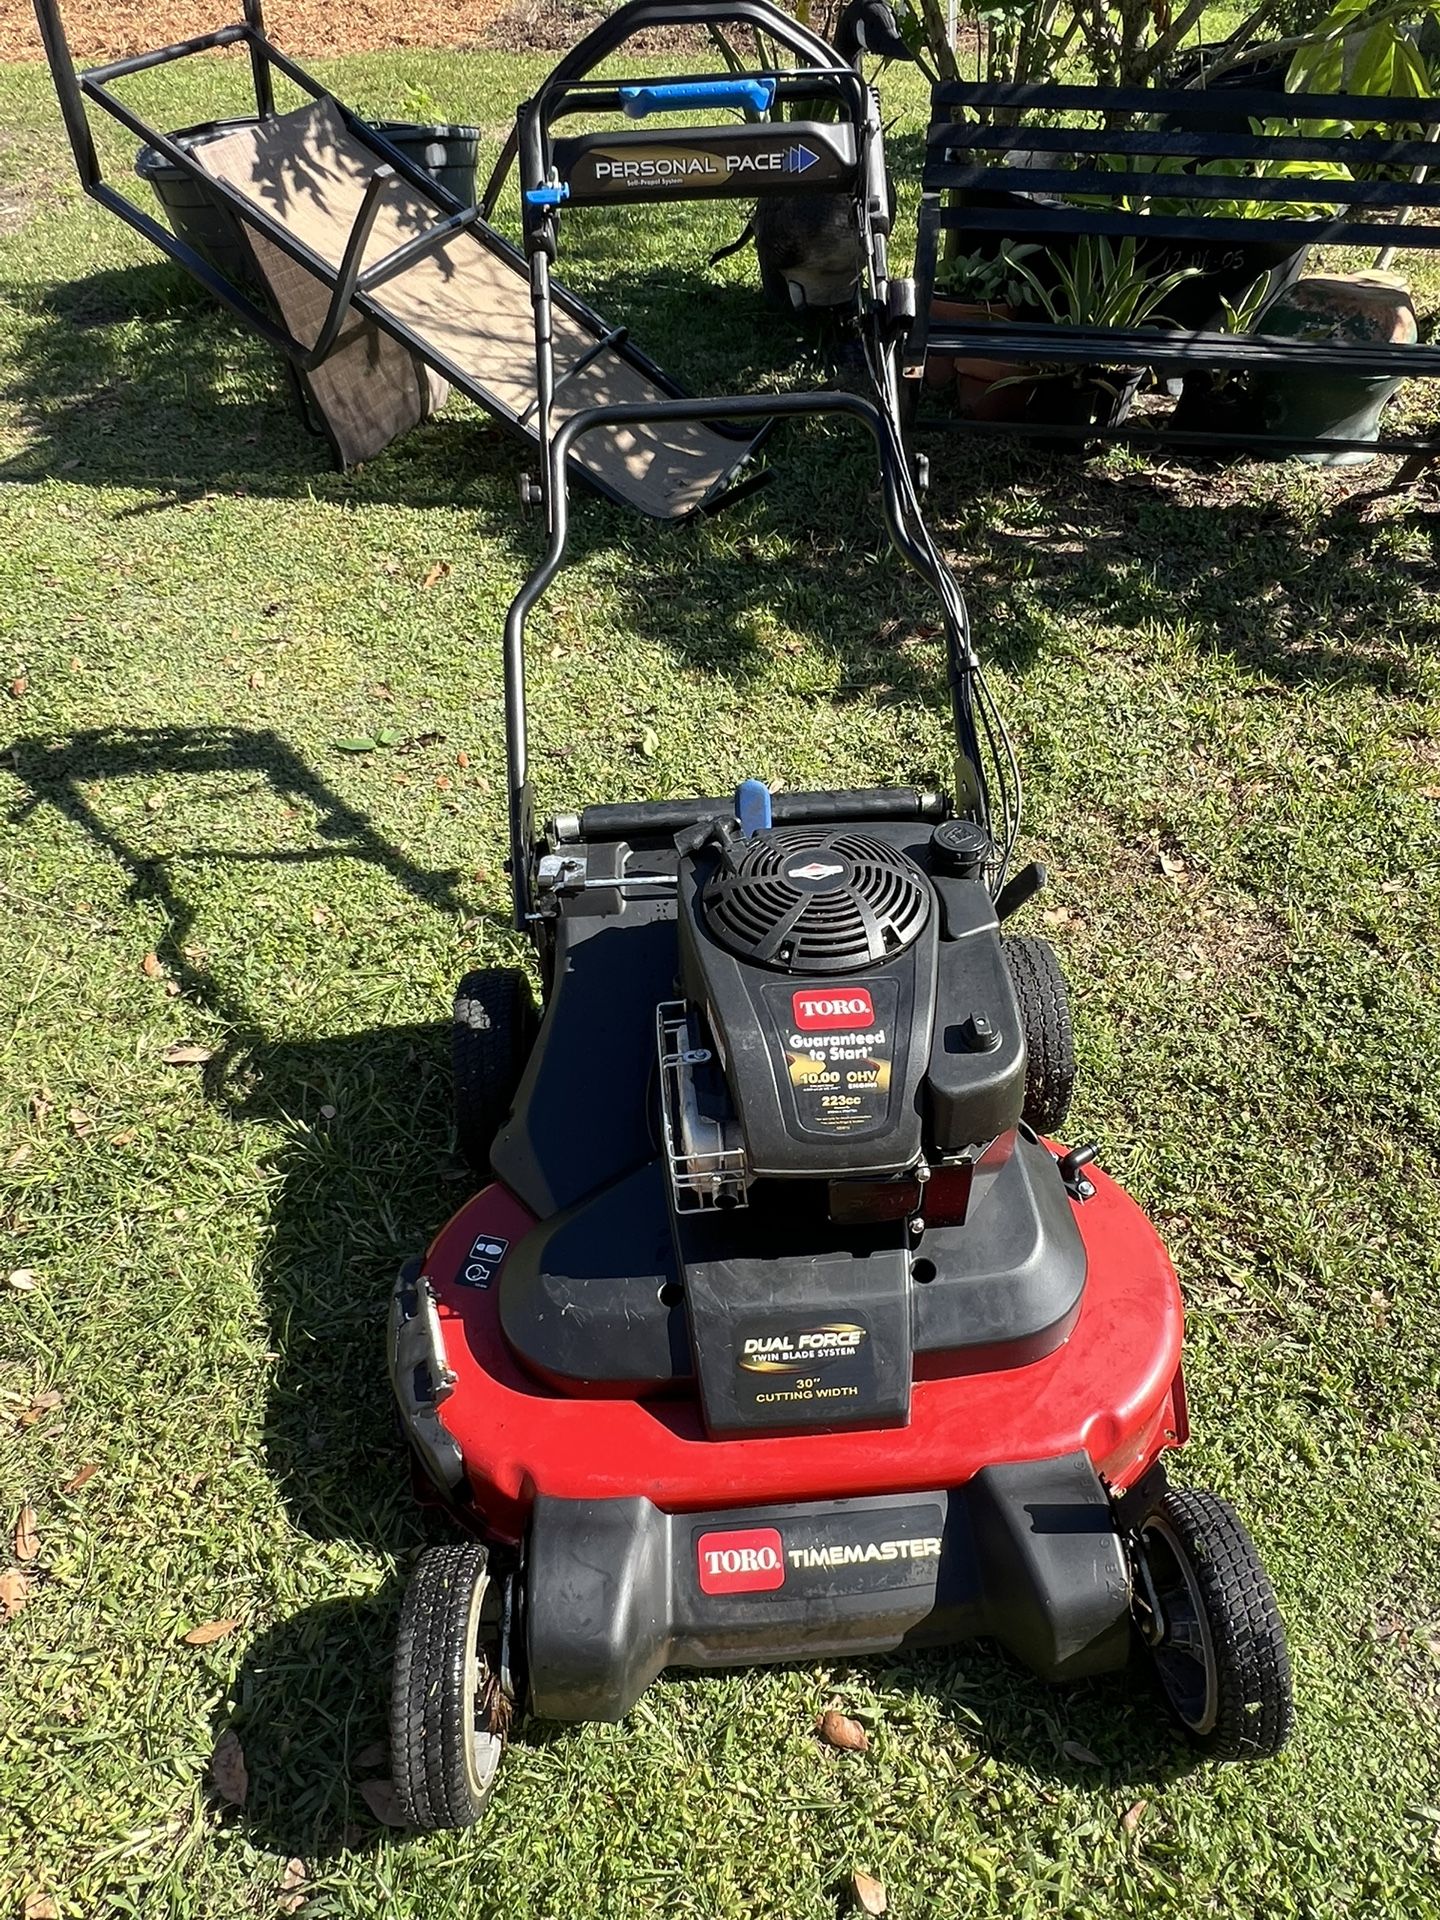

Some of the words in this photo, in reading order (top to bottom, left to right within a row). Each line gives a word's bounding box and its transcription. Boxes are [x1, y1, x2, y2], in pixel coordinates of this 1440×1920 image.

[596, 157, 716, 179] PERSONAL
[726, 153, 782, 171] PACE
[661, 177, 683, 187] System
[789, 1030, 886, 1049] Guaranteed
[809, 1050, 826, 1061] to
[800, 1071, 841, 1084] 10.00
[846, 1070, 877, 1083] OHV
[821, 1095, 862, 1107] 223cc
[744, 1336, 794, 1353] DUAL
[752, 1353, 779, 1362] TWIN
[782, 1350, 815, 1360] BLADE
[818, 1347, 856, 1358] SYSTEM
[756, 1390, 813, 1402] CUTTING
[816, 1386, 858, 1398] WIDTH
[788, 1537, 942, 1568] TIMEMASTER
